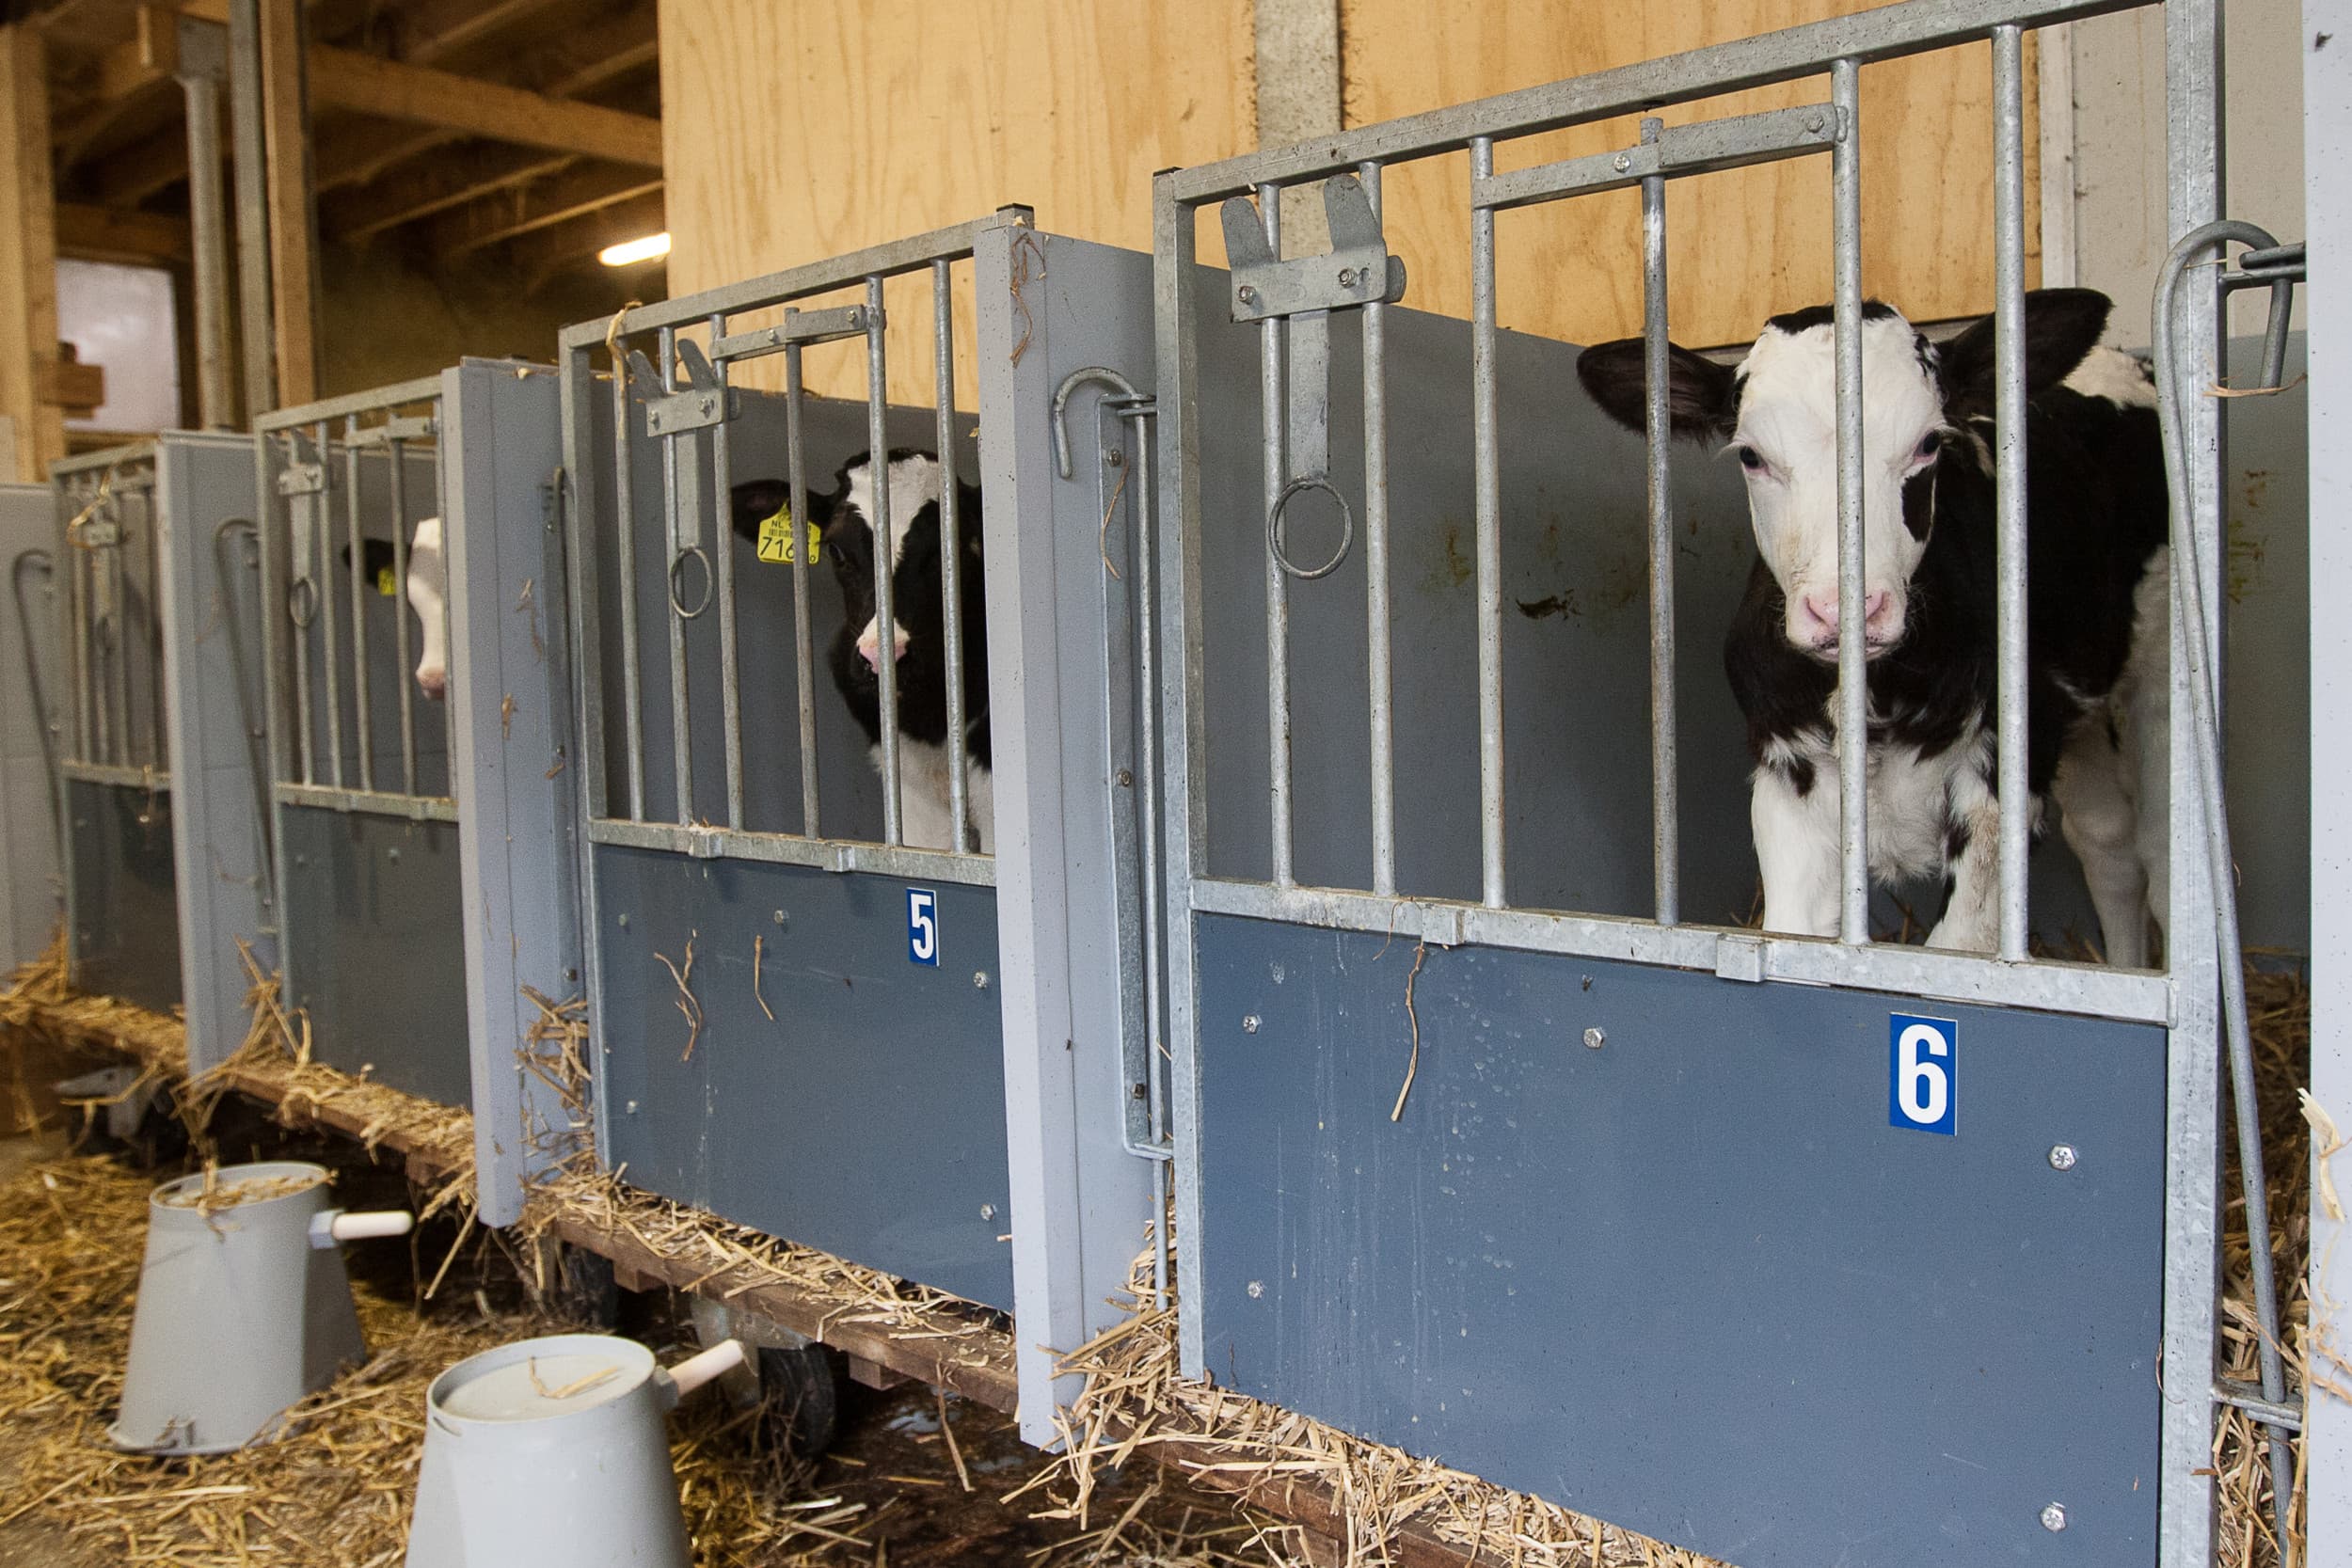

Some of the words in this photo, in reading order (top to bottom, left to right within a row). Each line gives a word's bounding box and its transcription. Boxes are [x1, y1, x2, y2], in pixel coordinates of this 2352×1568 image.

[760, 536, 809, 560] 716
[911, 894, 934, 959] 5
[1899, 1023, 1947, 1124] 6
